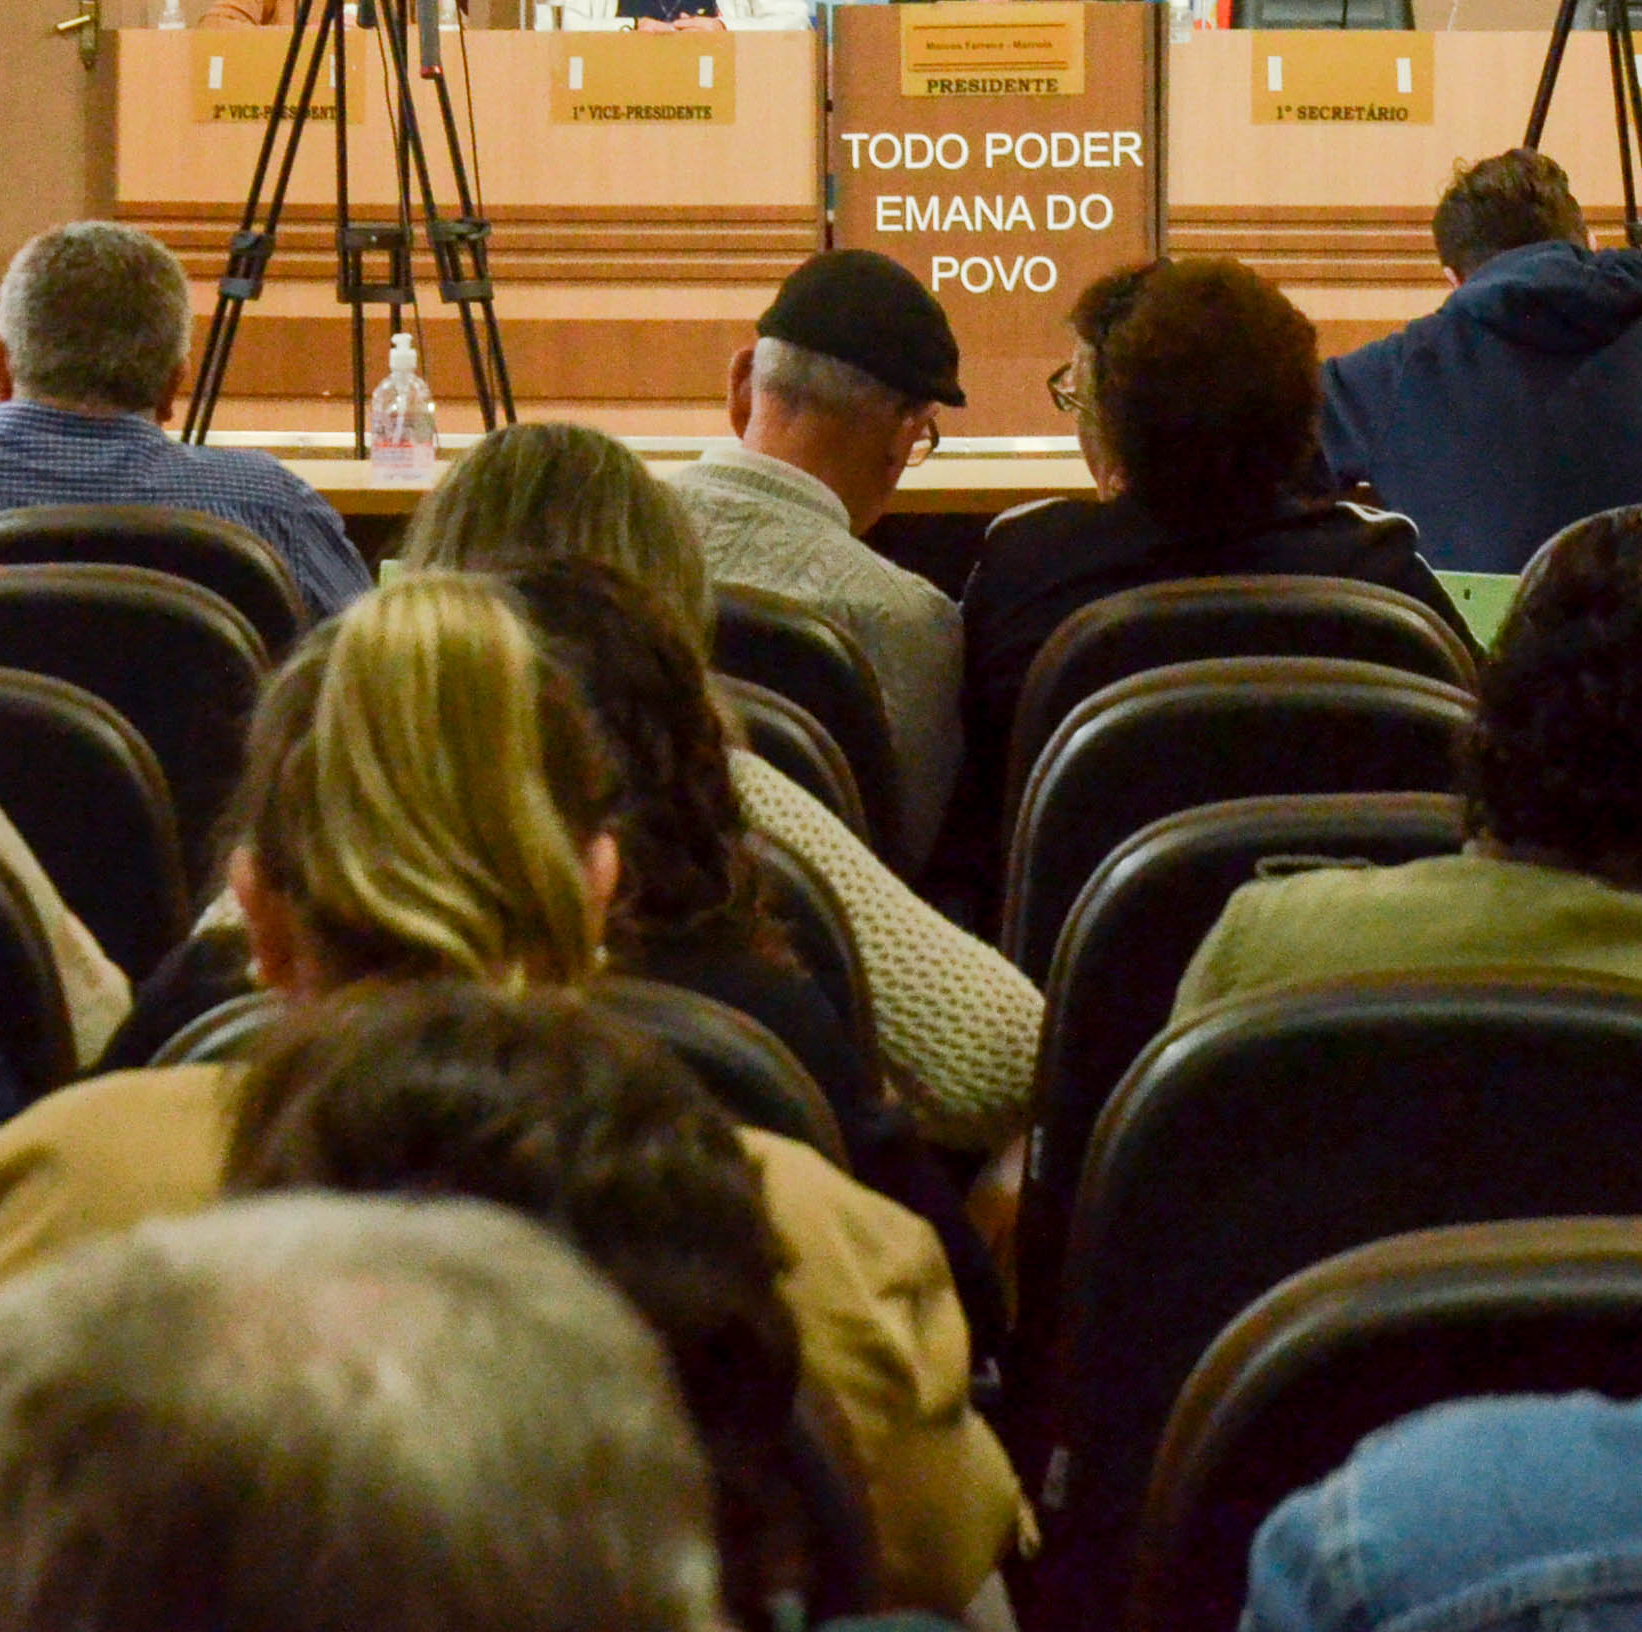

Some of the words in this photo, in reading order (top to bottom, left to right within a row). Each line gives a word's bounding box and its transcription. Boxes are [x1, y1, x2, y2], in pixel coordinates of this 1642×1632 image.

[926, 77, 1059, 94] PRESIDENTE
[589, 104, 712, 120] VICE-PRESIDENTE
[1297, 102, 1409, 121] SECRETÁRIO
[841, 132, 969, 170] TODO
[985, 131, 1145, 169] PODER
[875, 195, 1036, 233] EMANA
[1047, 194, 1114, 231] DO
[931, 256, 1058, 294] POVO
